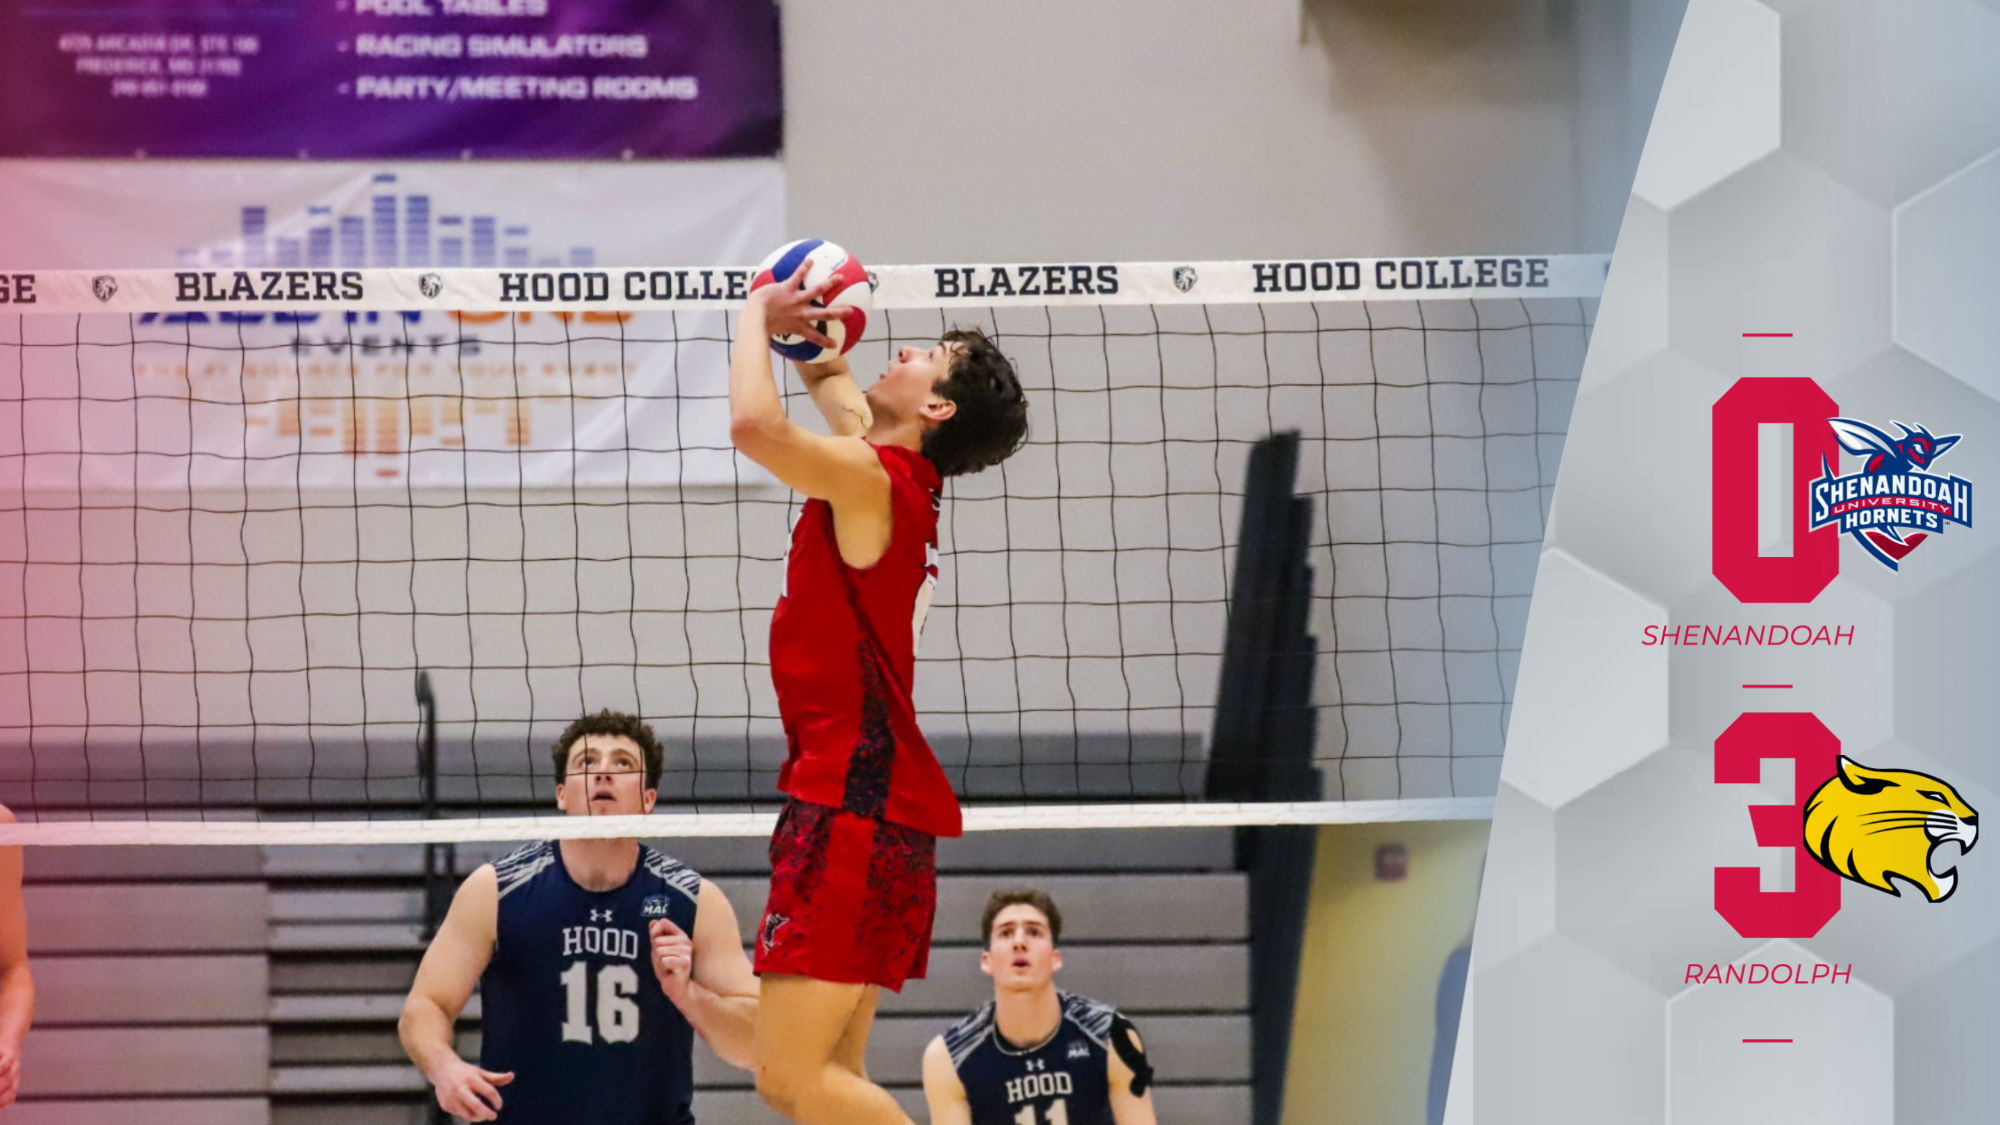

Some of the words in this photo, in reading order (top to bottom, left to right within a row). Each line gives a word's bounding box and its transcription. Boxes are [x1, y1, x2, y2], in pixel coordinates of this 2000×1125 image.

[356, 34, 462, 58] RACING
[467, 34, 648, 58] SIMULATORS
[356, 76, 588, 102] PARTY/MEETING
[592, 76, 698, 100] ROOMS
[174, 271, 364, 302] BLAZERS
[499, 272, 609, 302] HOOD
[624, 271, 757, 301] COLLE
[934, 265, 1119, 298] BLAZERS
[1252, 261, 1361, 293] HOOD
[1375, 257, 1550, 290] COLLEGE
[562, 926, 639, 960] HOOD
[560, 961, 640, 1045] 16
[1005, 1071, 1073, 1103] HOOD
